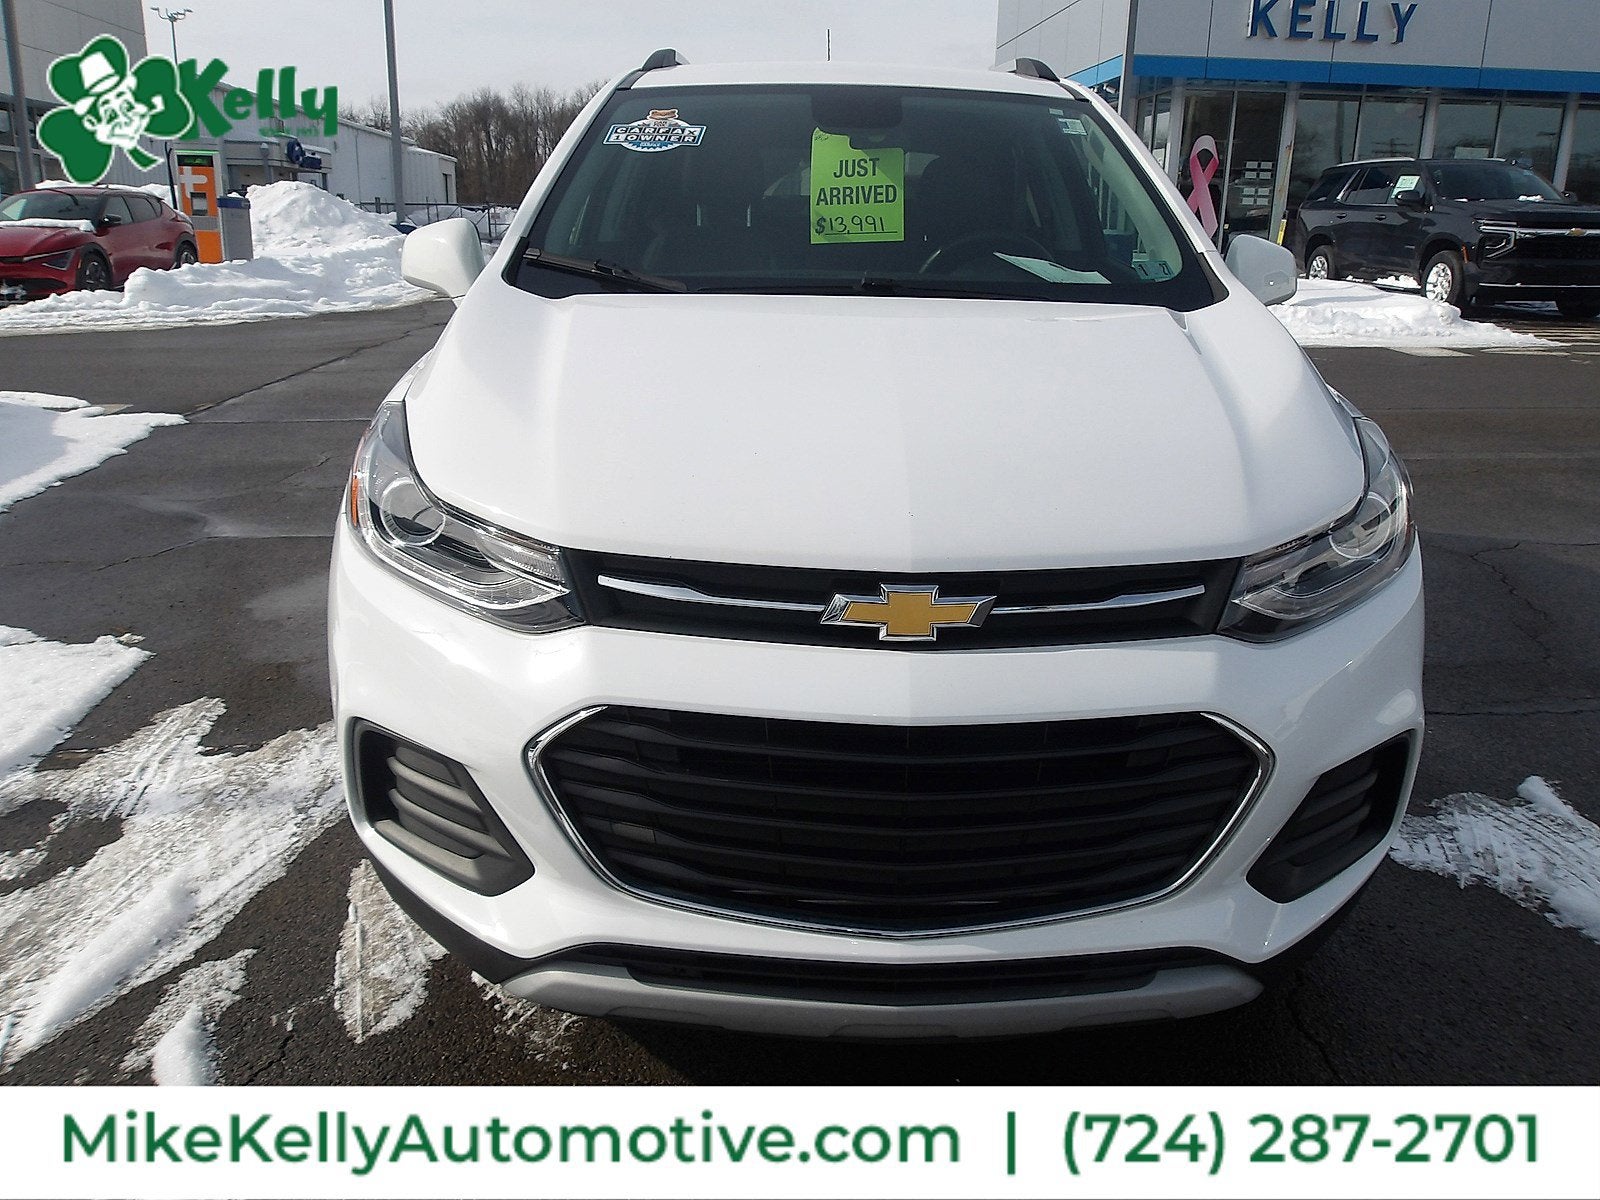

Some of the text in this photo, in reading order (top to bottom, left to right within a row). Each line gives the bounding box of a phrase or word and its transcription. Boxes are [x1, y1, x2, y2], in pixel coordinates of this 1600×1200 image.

[1247, 0, 1417, 44] KELLY
[616, 126, 697, 135] CARFAX
[626, 134, 695, 143] OWNER
[833, 158, 880, 178] JUST
[816, 184, 897, 206] ARRIVED
[815, 215, 885, 235] $13,991
